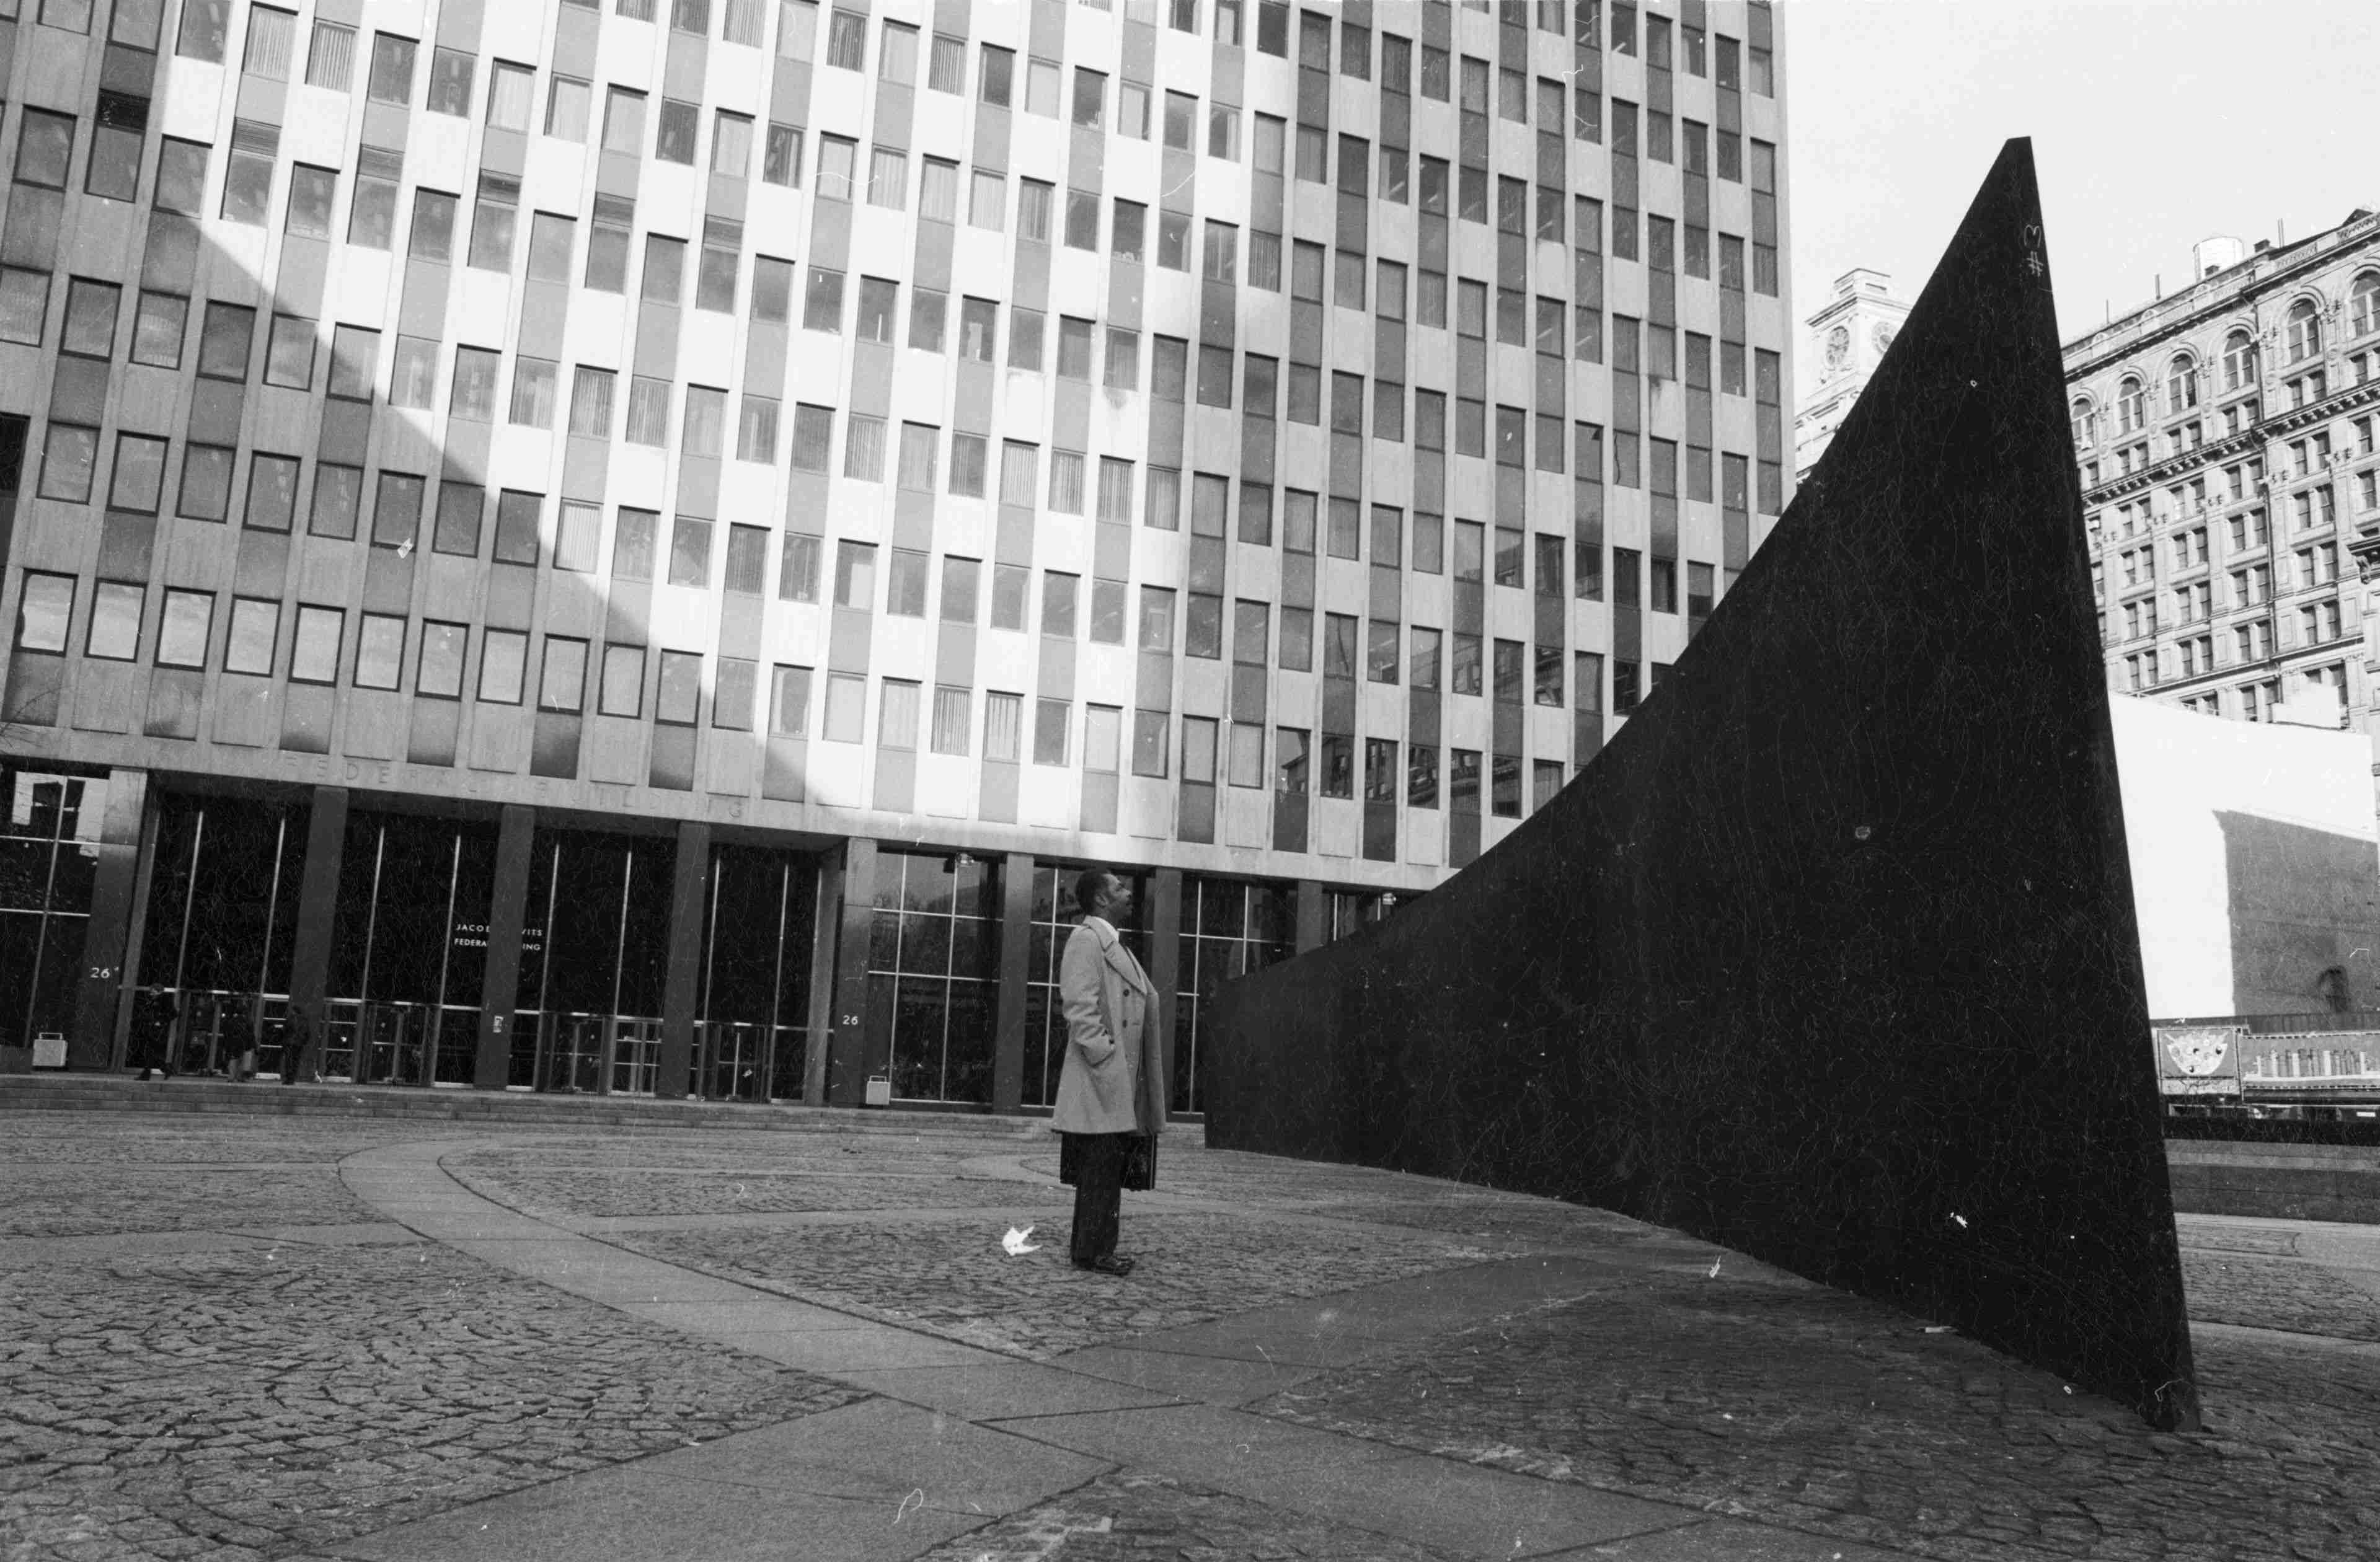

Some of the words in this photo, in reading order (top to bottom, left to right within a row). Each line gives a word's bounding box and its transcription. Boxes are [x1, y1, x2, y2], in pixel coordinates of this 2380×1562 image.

[454, 938, 487, 946] FEDERA
[90, 967, 110, 978] 26
[843, 1015, 859, 1025] 26
